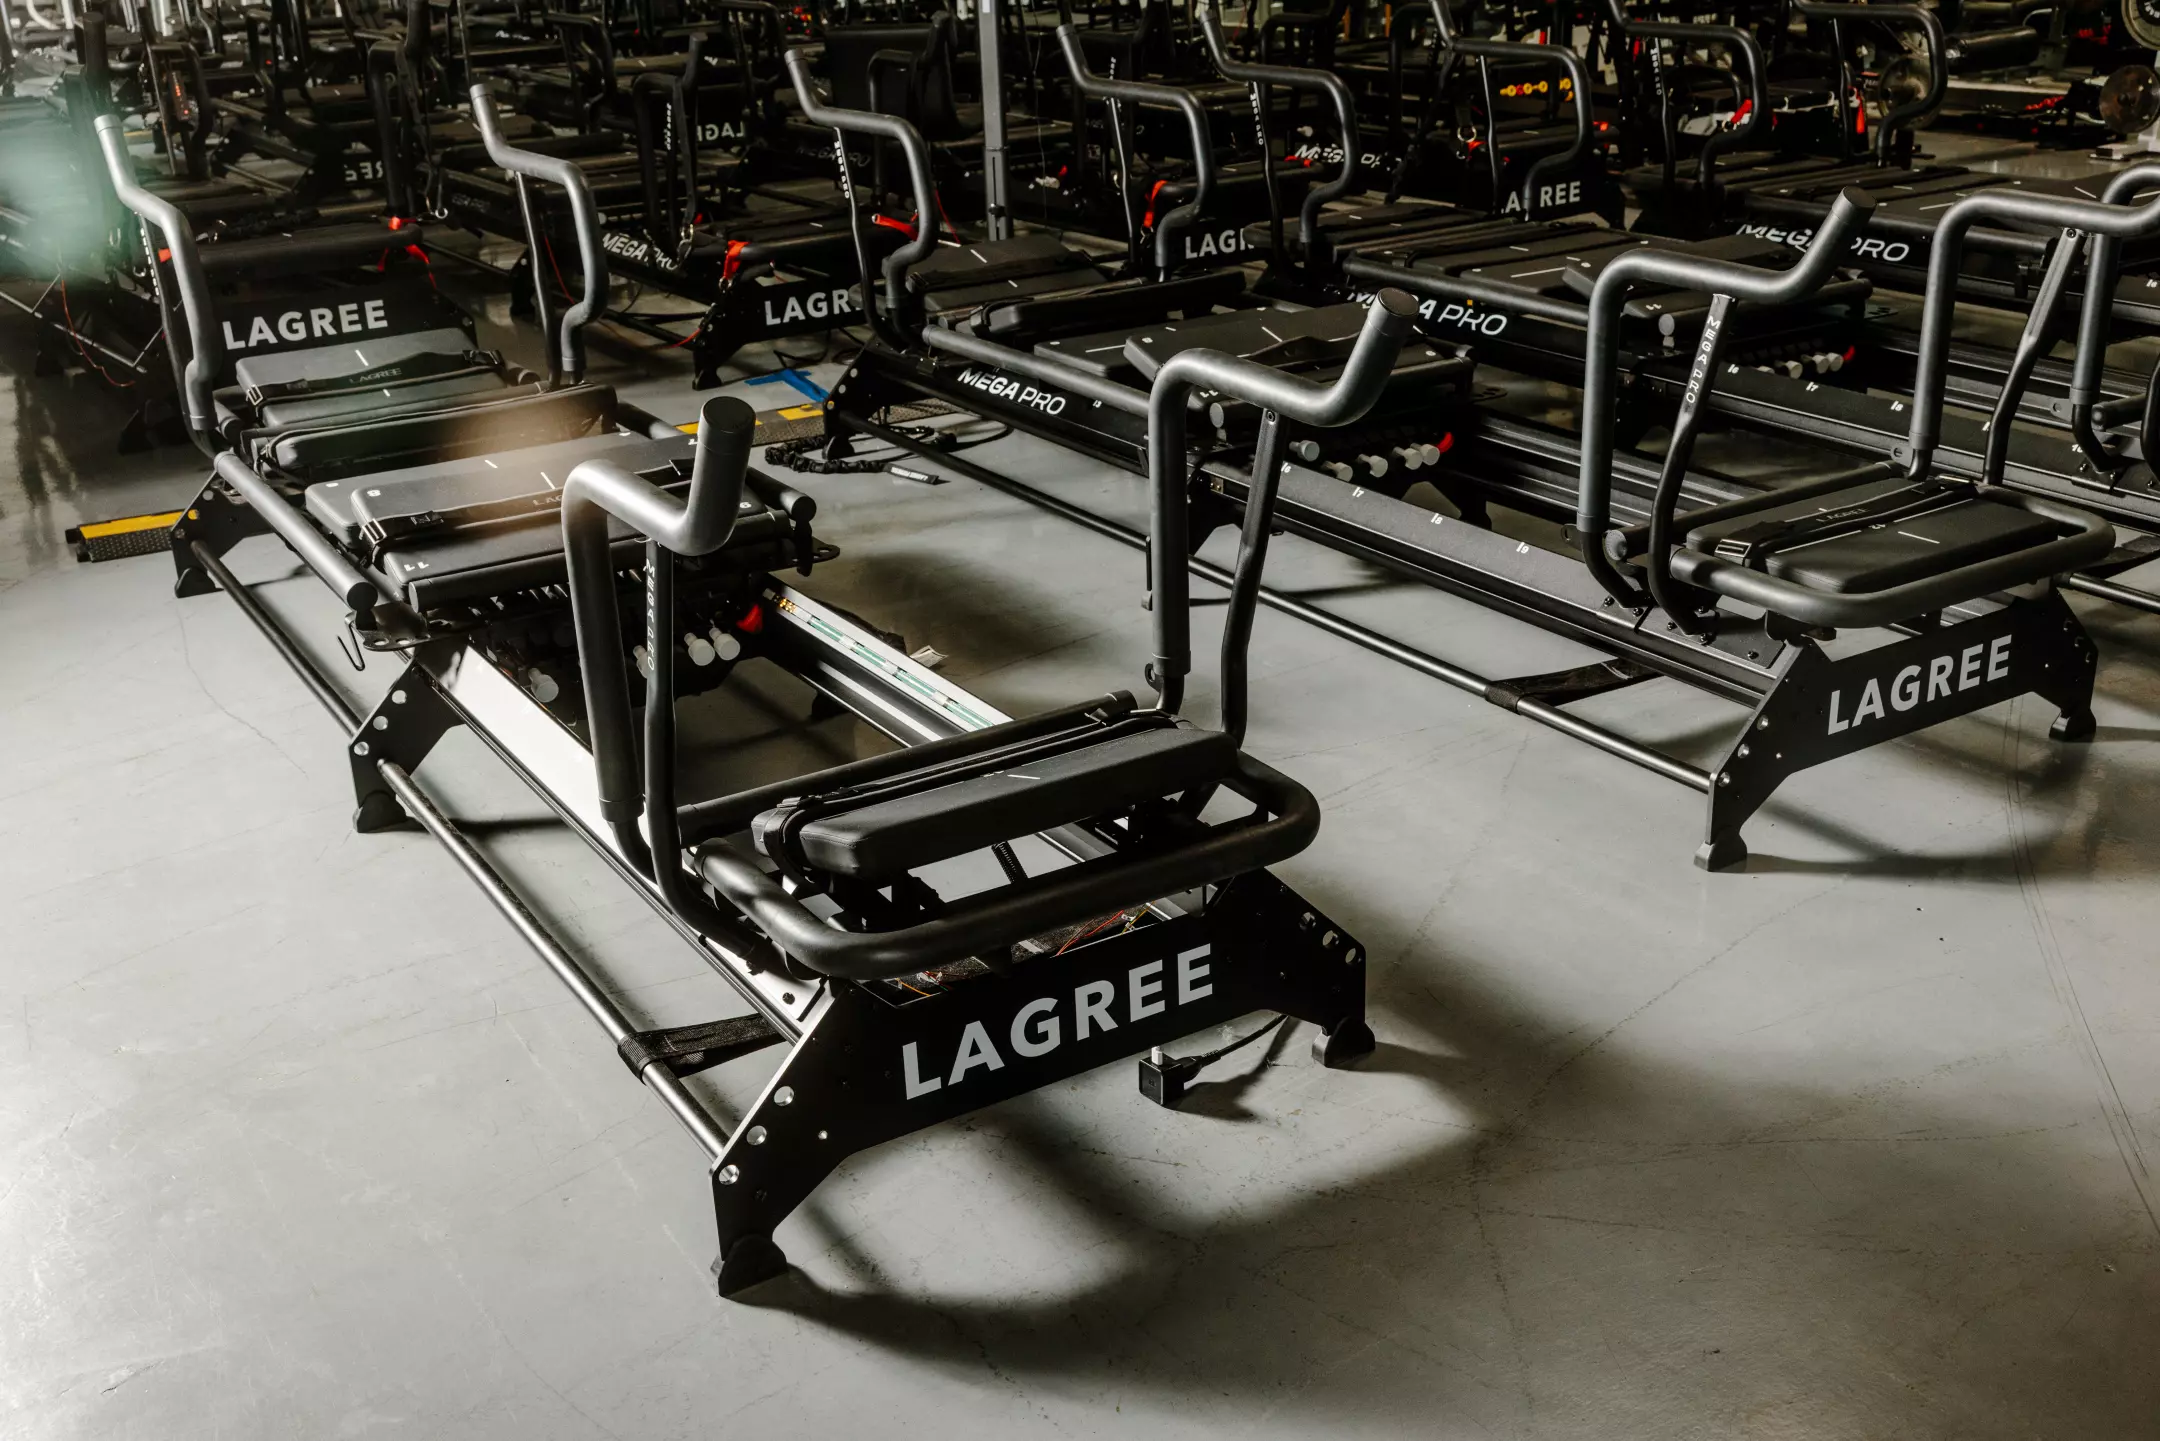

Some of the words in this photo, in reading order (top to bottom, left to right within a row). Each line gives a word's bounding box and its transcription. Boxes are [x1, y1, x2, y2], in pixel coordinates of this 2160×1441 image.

[222, 299, 388, 351] LAGREE
[1437, 303, 1508, 336] PRO
[1697, 314, 1722, 366] MEGA
[350, 366, 403, 385] LAGREE
[957, 367, 1021, 401] MEGA
[1018, 386, 1067, 416] PRO
[1684, 369, 1703, 405] PRO
[642, 558, 656, 624] MEGA
[646, 626, 656, 671] PRO
[1827, 634, 2013, 736] LAGREE
[902, 942, 1213, 1101] LAGREE
